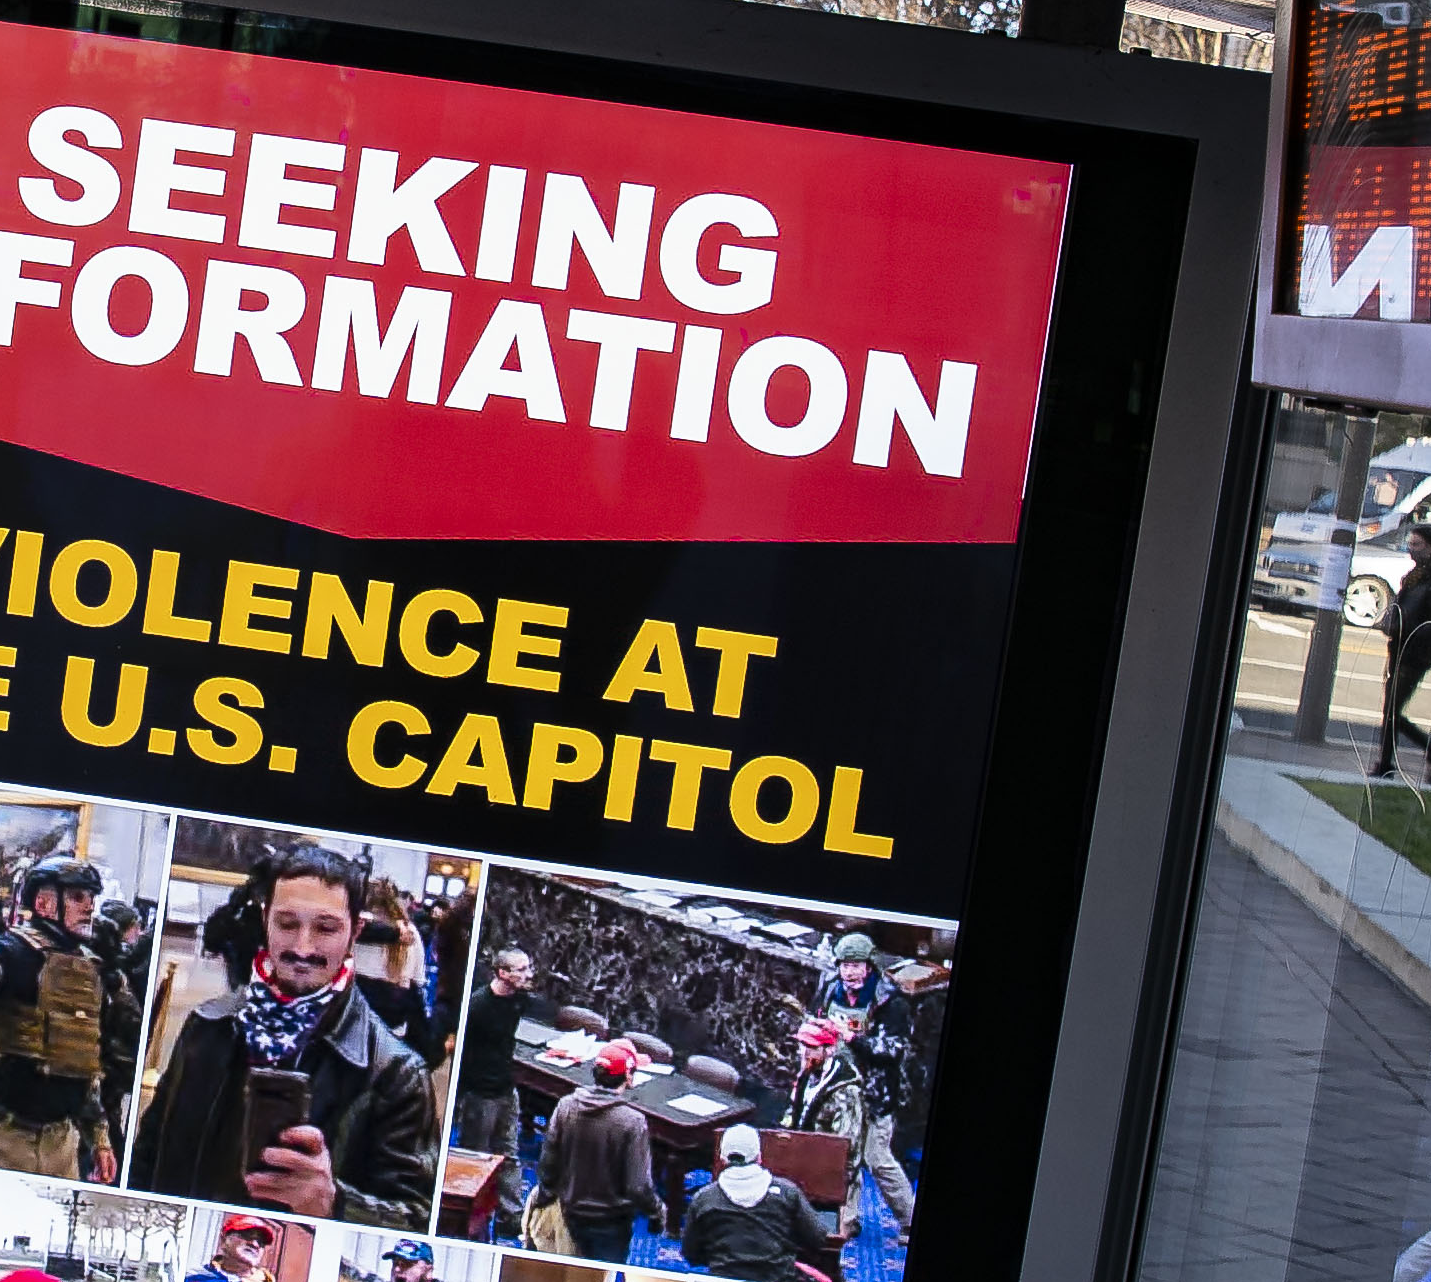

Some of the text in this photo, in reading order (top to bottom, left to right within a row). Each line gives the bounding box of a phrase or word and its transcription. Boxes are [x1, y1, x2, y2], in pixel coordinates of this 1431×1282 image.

[19, 107, 780, 315] SEEKING
[60, 655, 300, 775] U.S.
[346, 699, 895, 860] CAPITOL
[603, 619, 779, 719] AT
